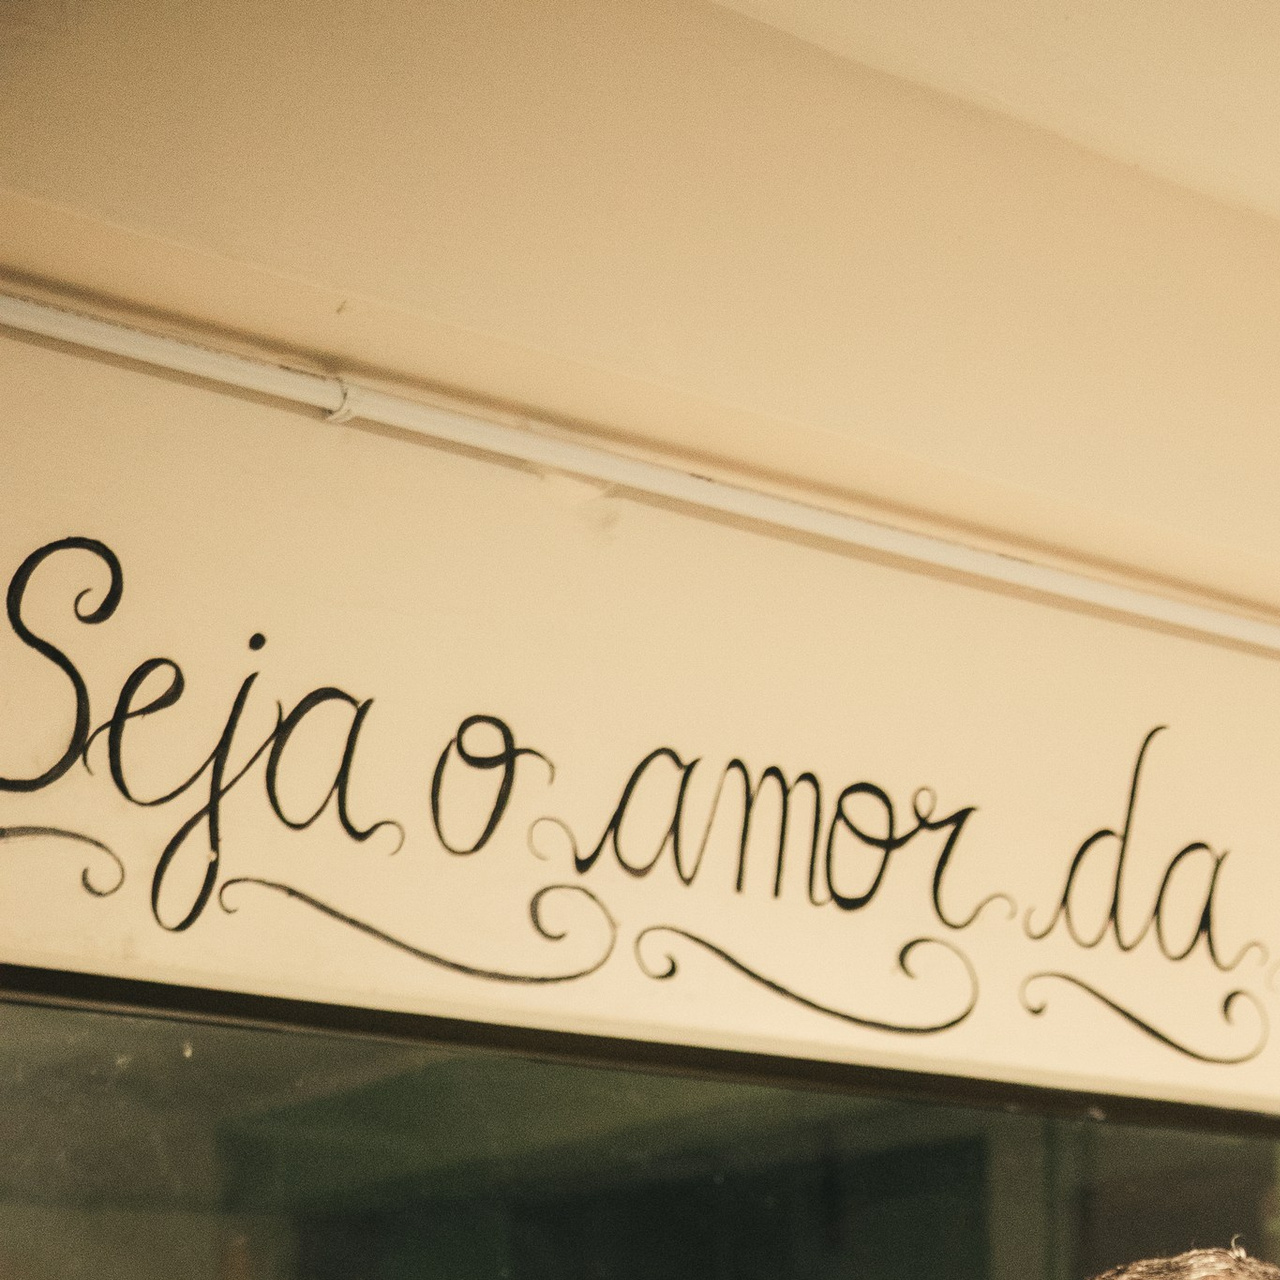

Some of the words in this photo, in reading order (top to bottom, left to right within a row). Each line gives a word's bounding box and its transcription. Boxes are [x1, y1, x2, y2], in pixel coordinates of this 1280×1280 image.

[0, 536, 404, 931] Seja
[431, 714, 556, 856] o
[529, 746, 1016, 929] amor
[1023, 726, 1269, 971] da
